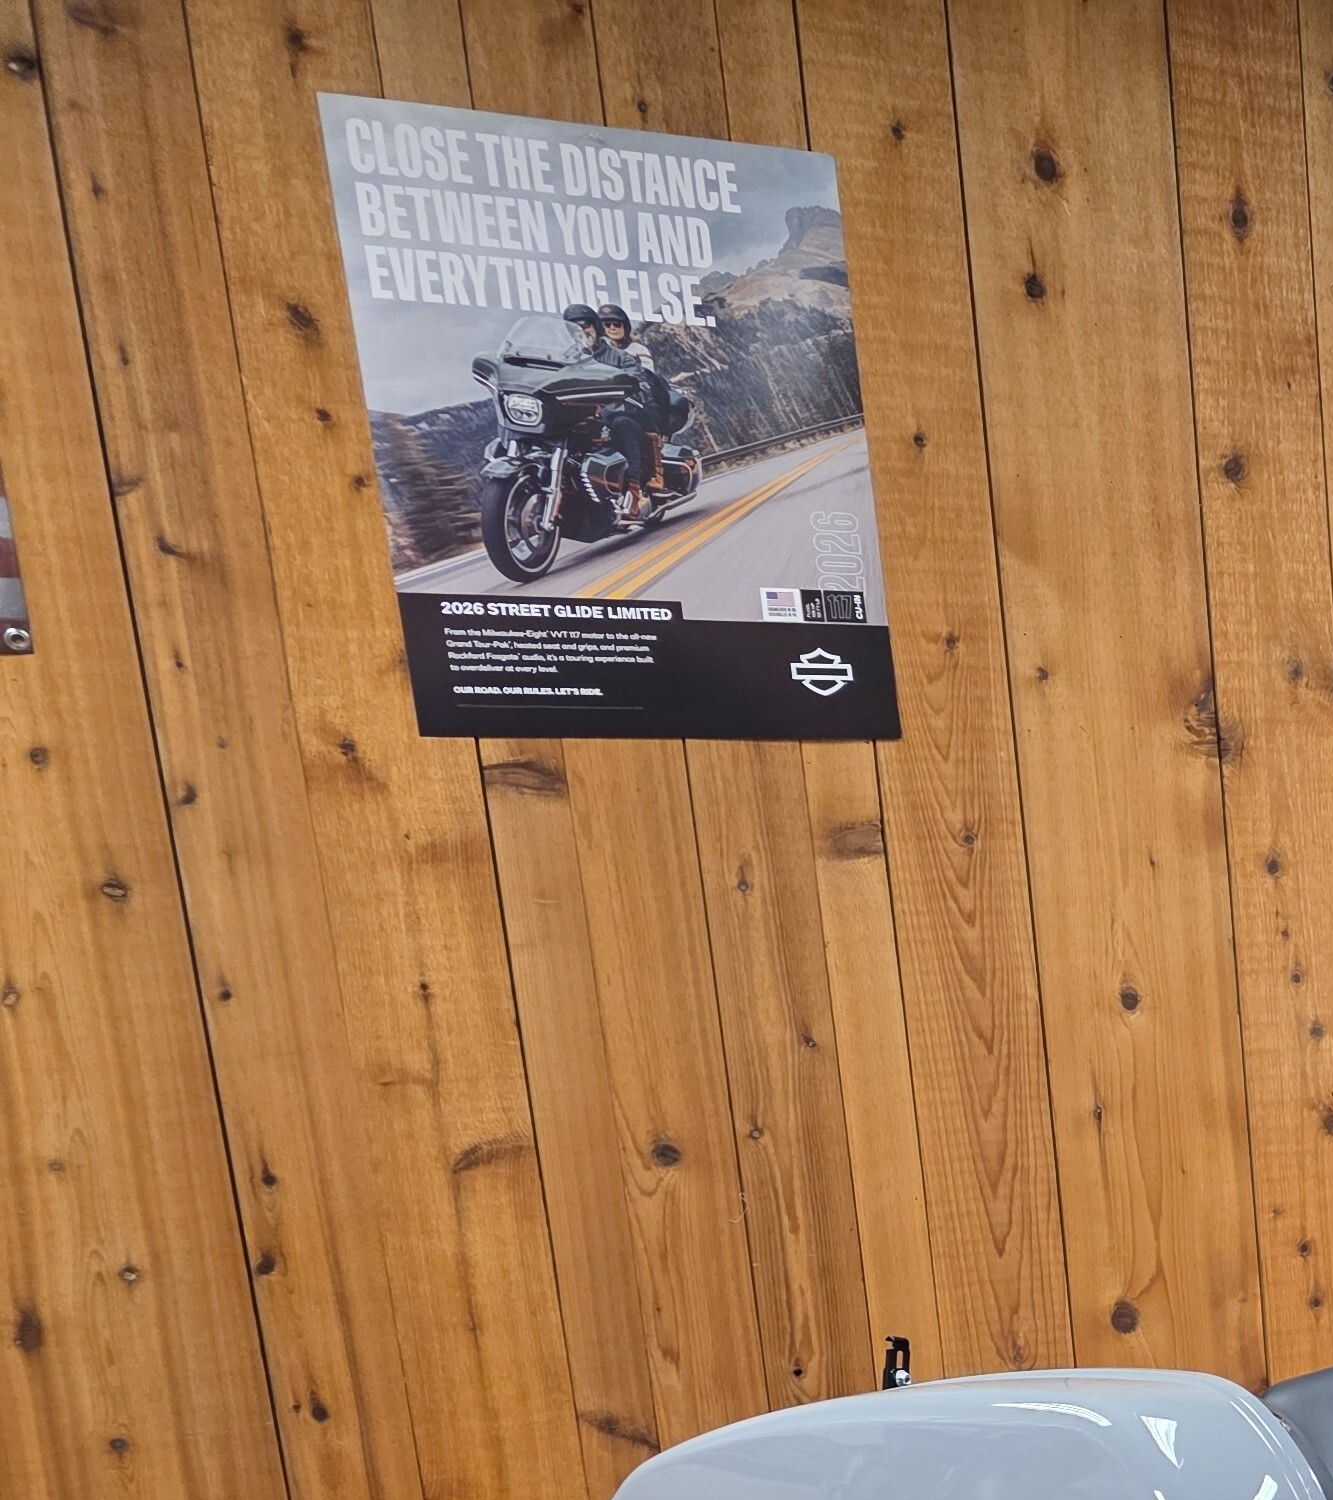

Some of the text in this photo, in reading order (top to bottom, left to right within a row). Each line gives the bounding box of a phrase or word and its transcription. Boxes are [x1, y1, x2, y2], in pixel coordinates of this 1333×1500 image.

[346, 118, 741, 213] CLOSE THE DISTANCE
[355, 181, 713, 269] BETWEEN YOU AND
[364, 245, 716, 328] EVERYTHING ELSE.
[810, 511, 865, 591] 2026
[440, 602, 673, 621] 2026 STREET GLIDE LIMITED
